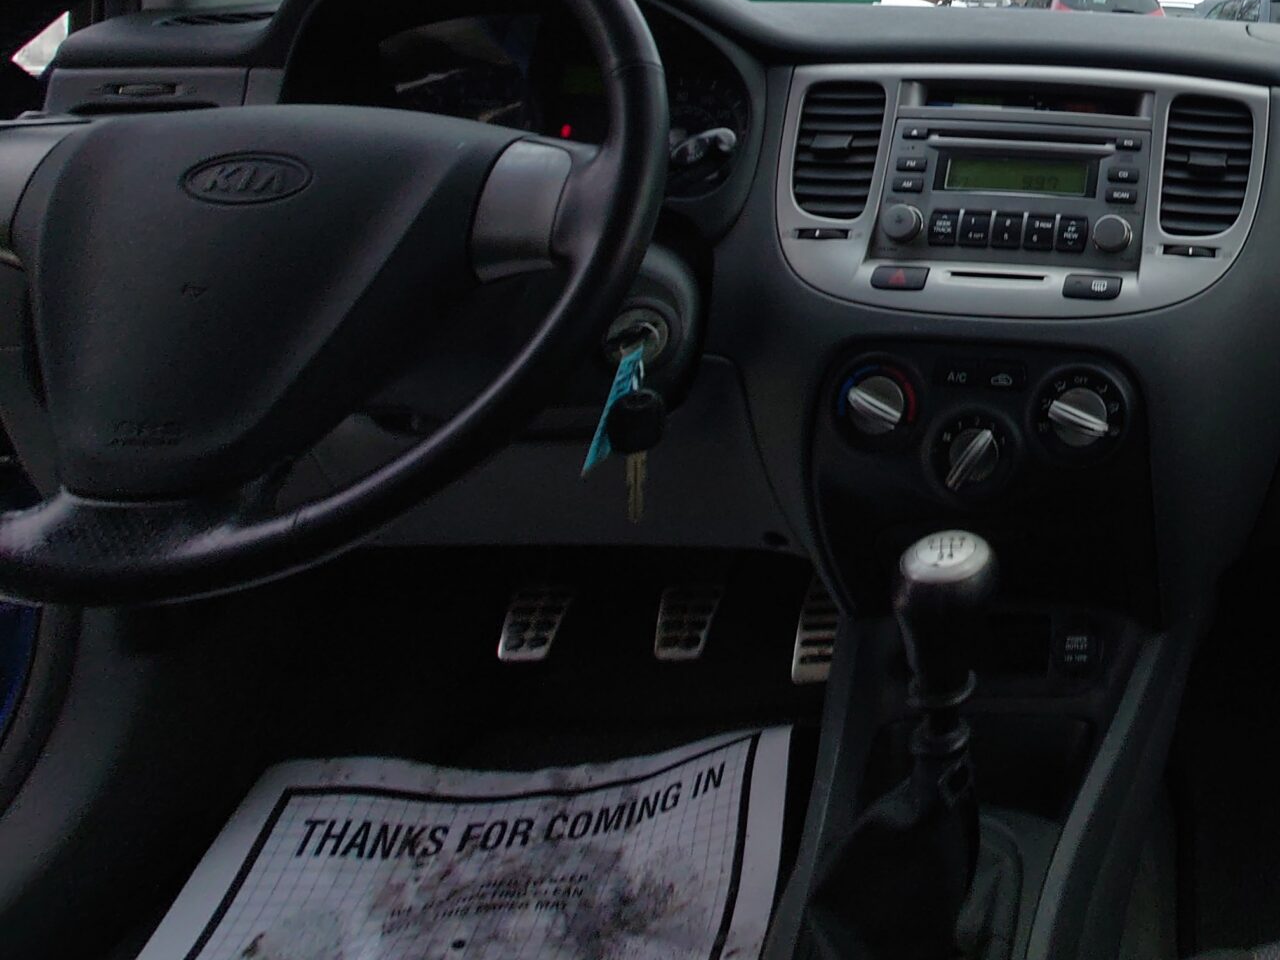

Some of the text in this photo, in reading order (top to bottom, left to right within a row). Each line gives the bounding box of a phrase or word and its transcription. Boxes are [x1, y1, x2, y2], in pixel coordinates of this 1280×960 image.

[905, 159, 917, 168] FM
[202, 165, 285, 192] KIA
[901, 179, 913, 188] AM
[1112, 191, 1130, 200] SCAN
[946, 371, 968, 384] A/C
[295, 761, 726, 860] THANKS FOR COMING IN
